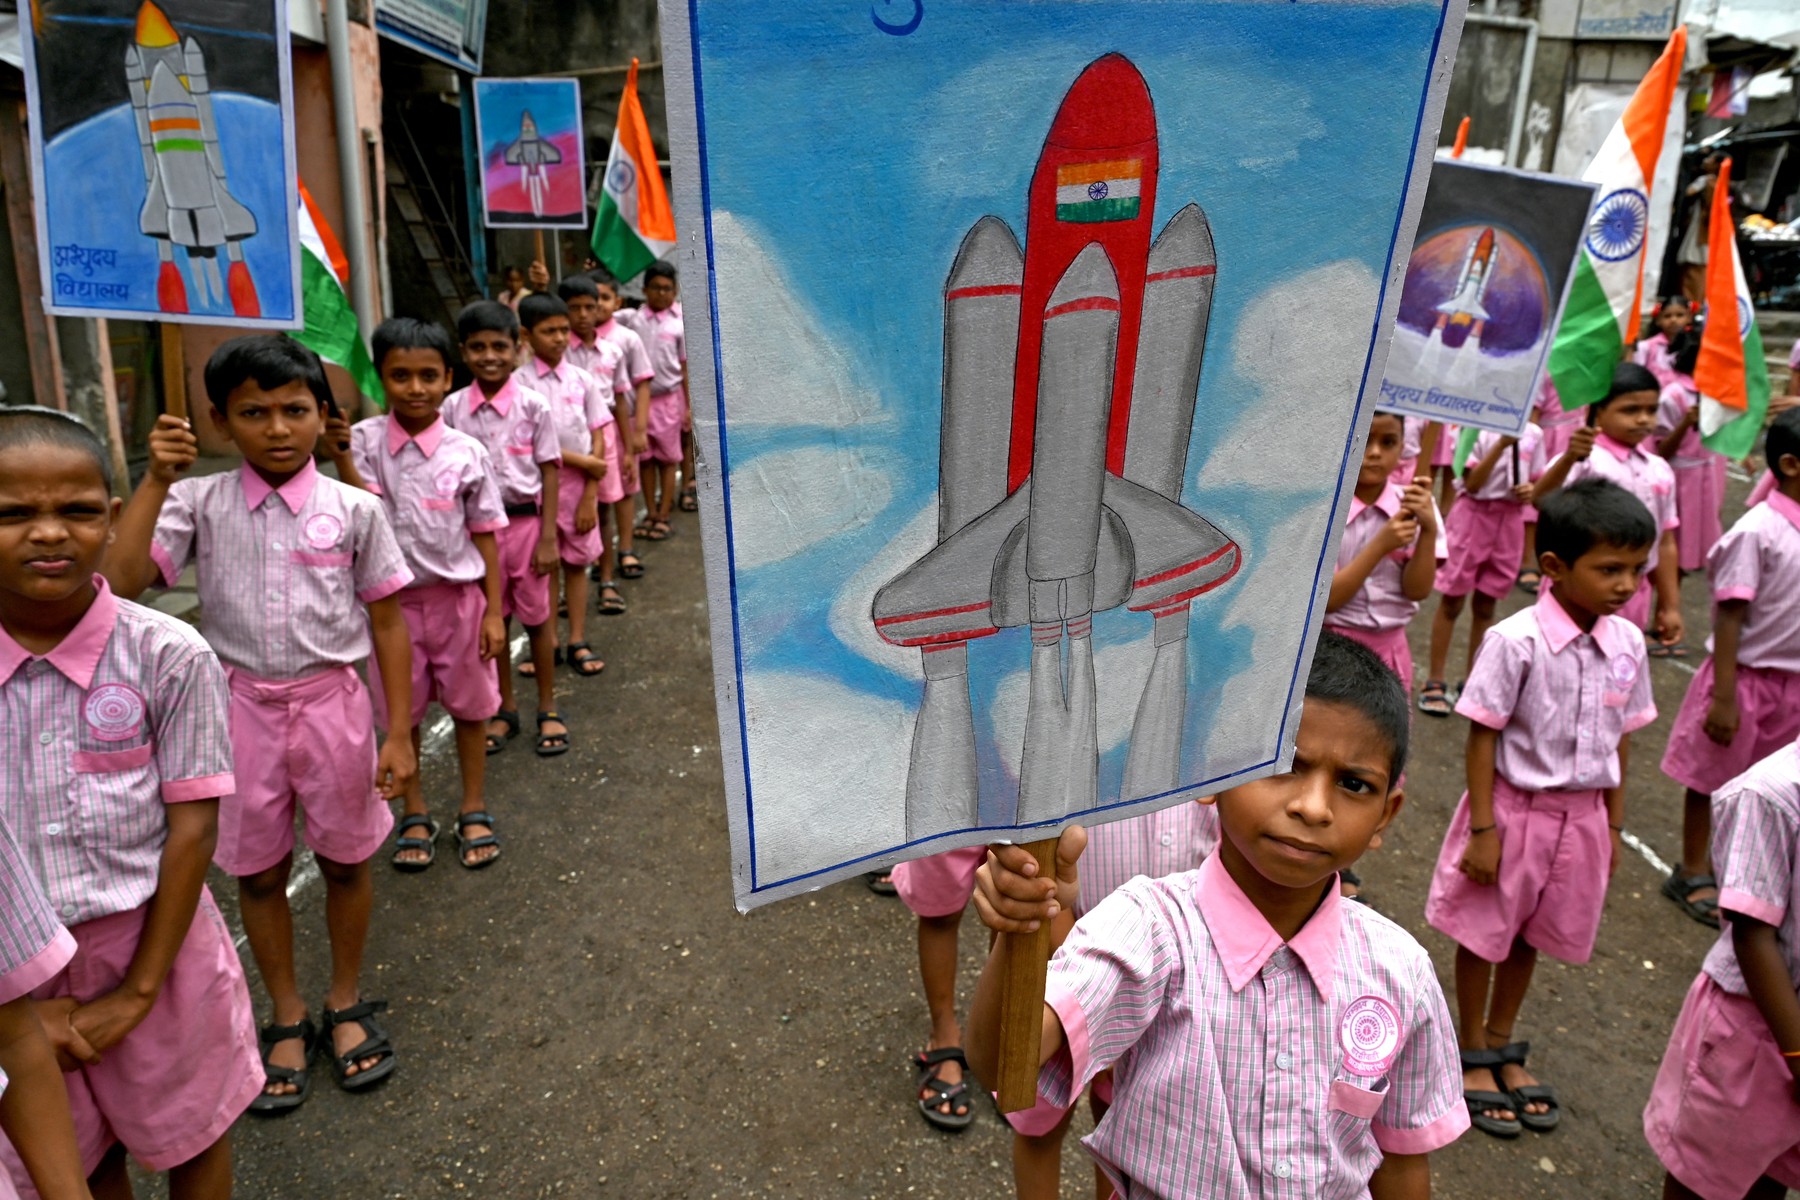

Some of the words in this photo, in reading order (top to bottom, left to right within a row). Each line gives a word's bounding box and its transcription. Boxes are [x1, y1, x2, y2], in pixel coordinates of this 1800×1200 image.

[55, 243, 118, 277] अभ्युदय
[55, 272, 129, 301] विद्यालय
[1425, 386, 1487, 415] विद्यालय
